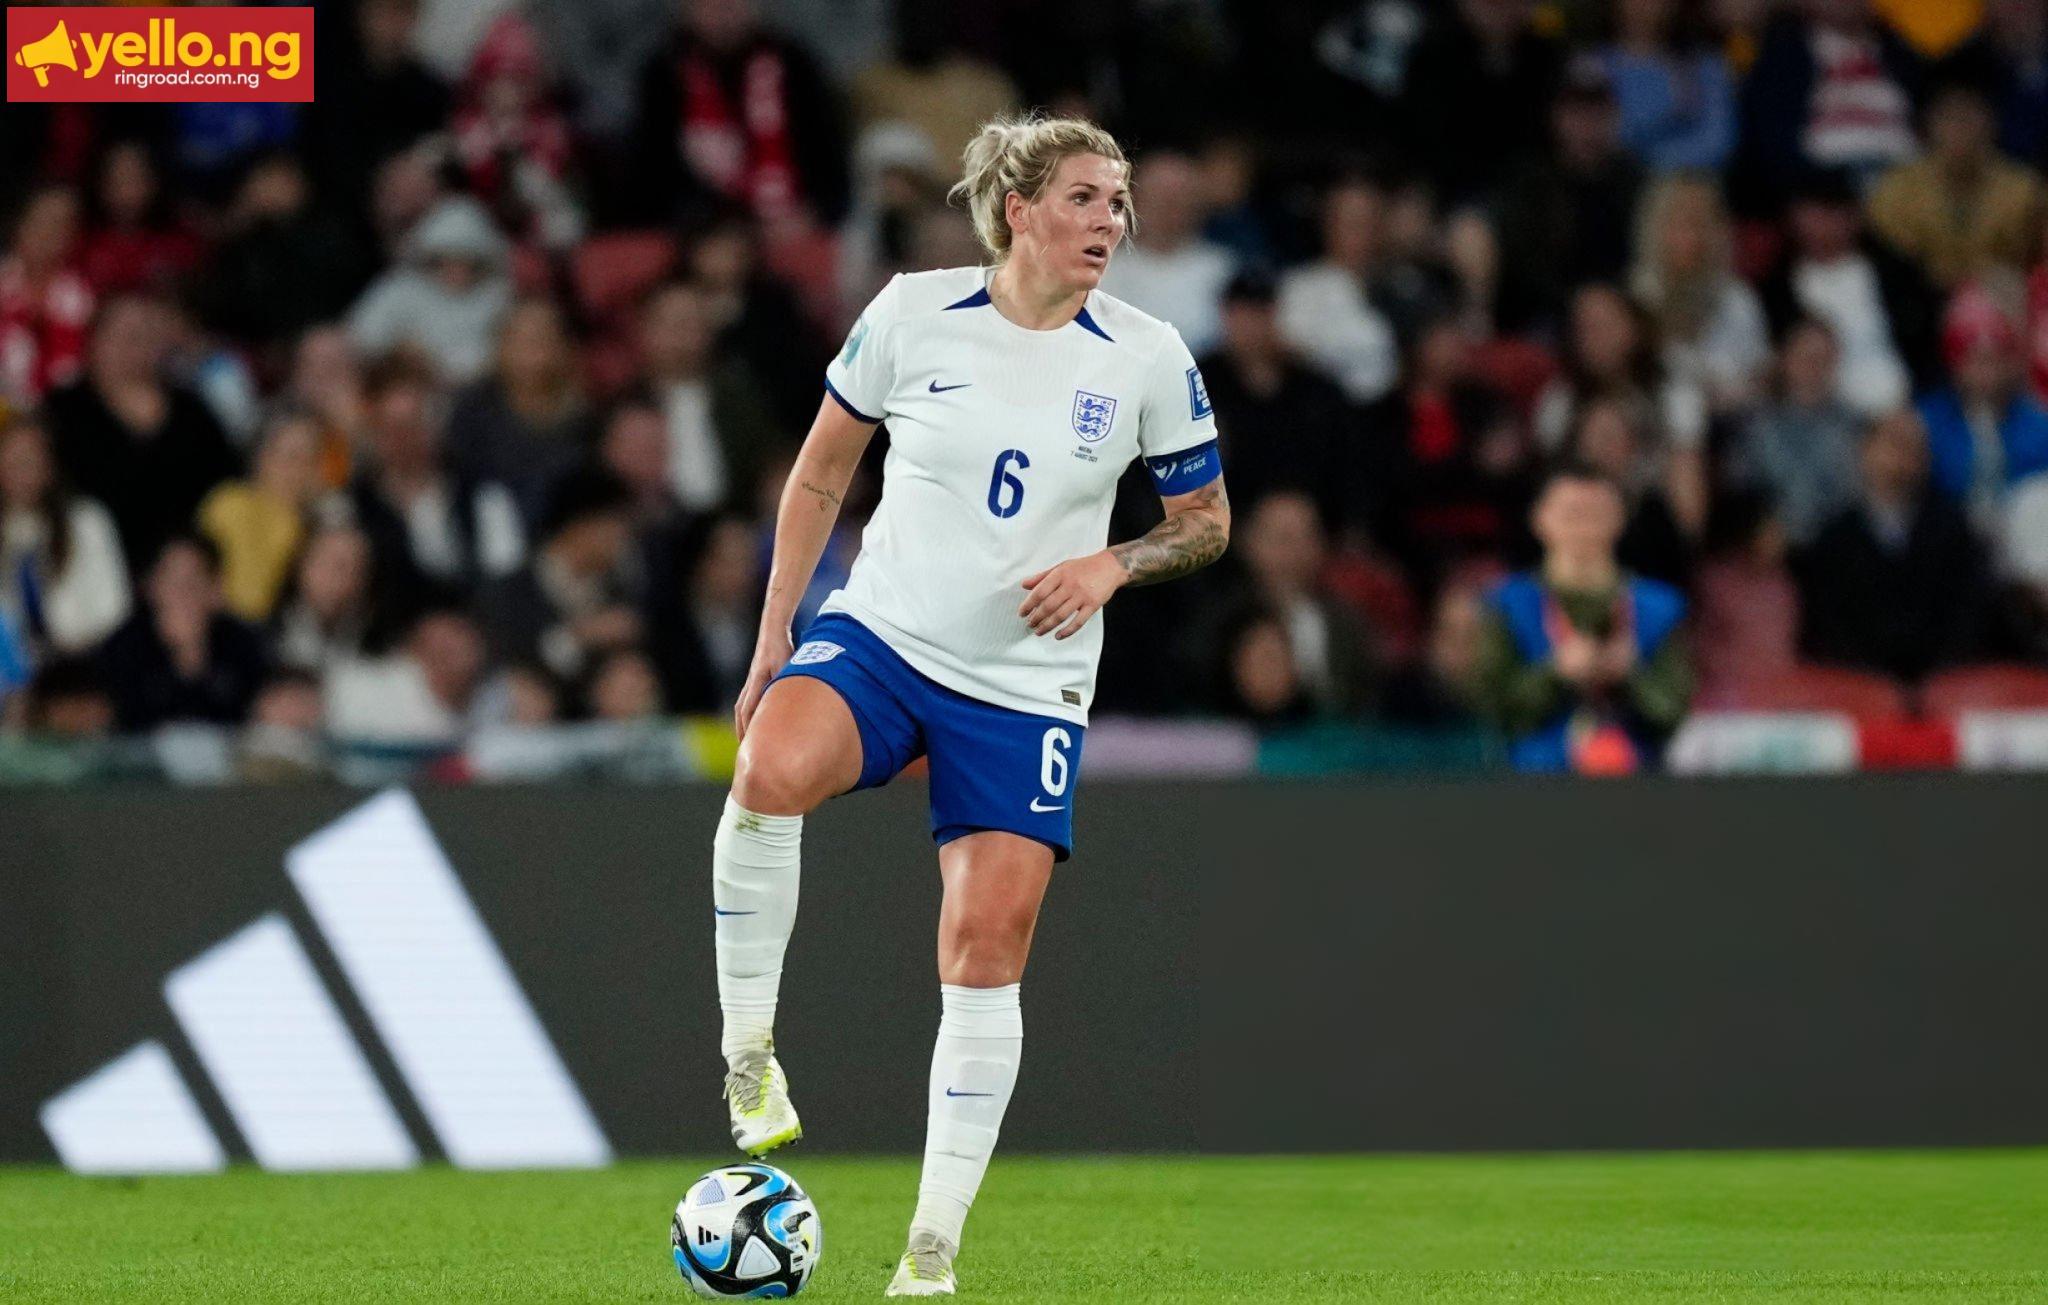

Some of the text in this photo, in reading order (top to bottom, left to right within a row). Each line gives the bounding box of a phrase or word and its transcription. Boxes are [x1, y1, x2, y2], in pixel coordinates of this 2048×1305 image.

[987, 448, 1030, 519] 6
[1183, 456, 1207, 475] PEACE
[1040, 726, 1072, 797] 6
